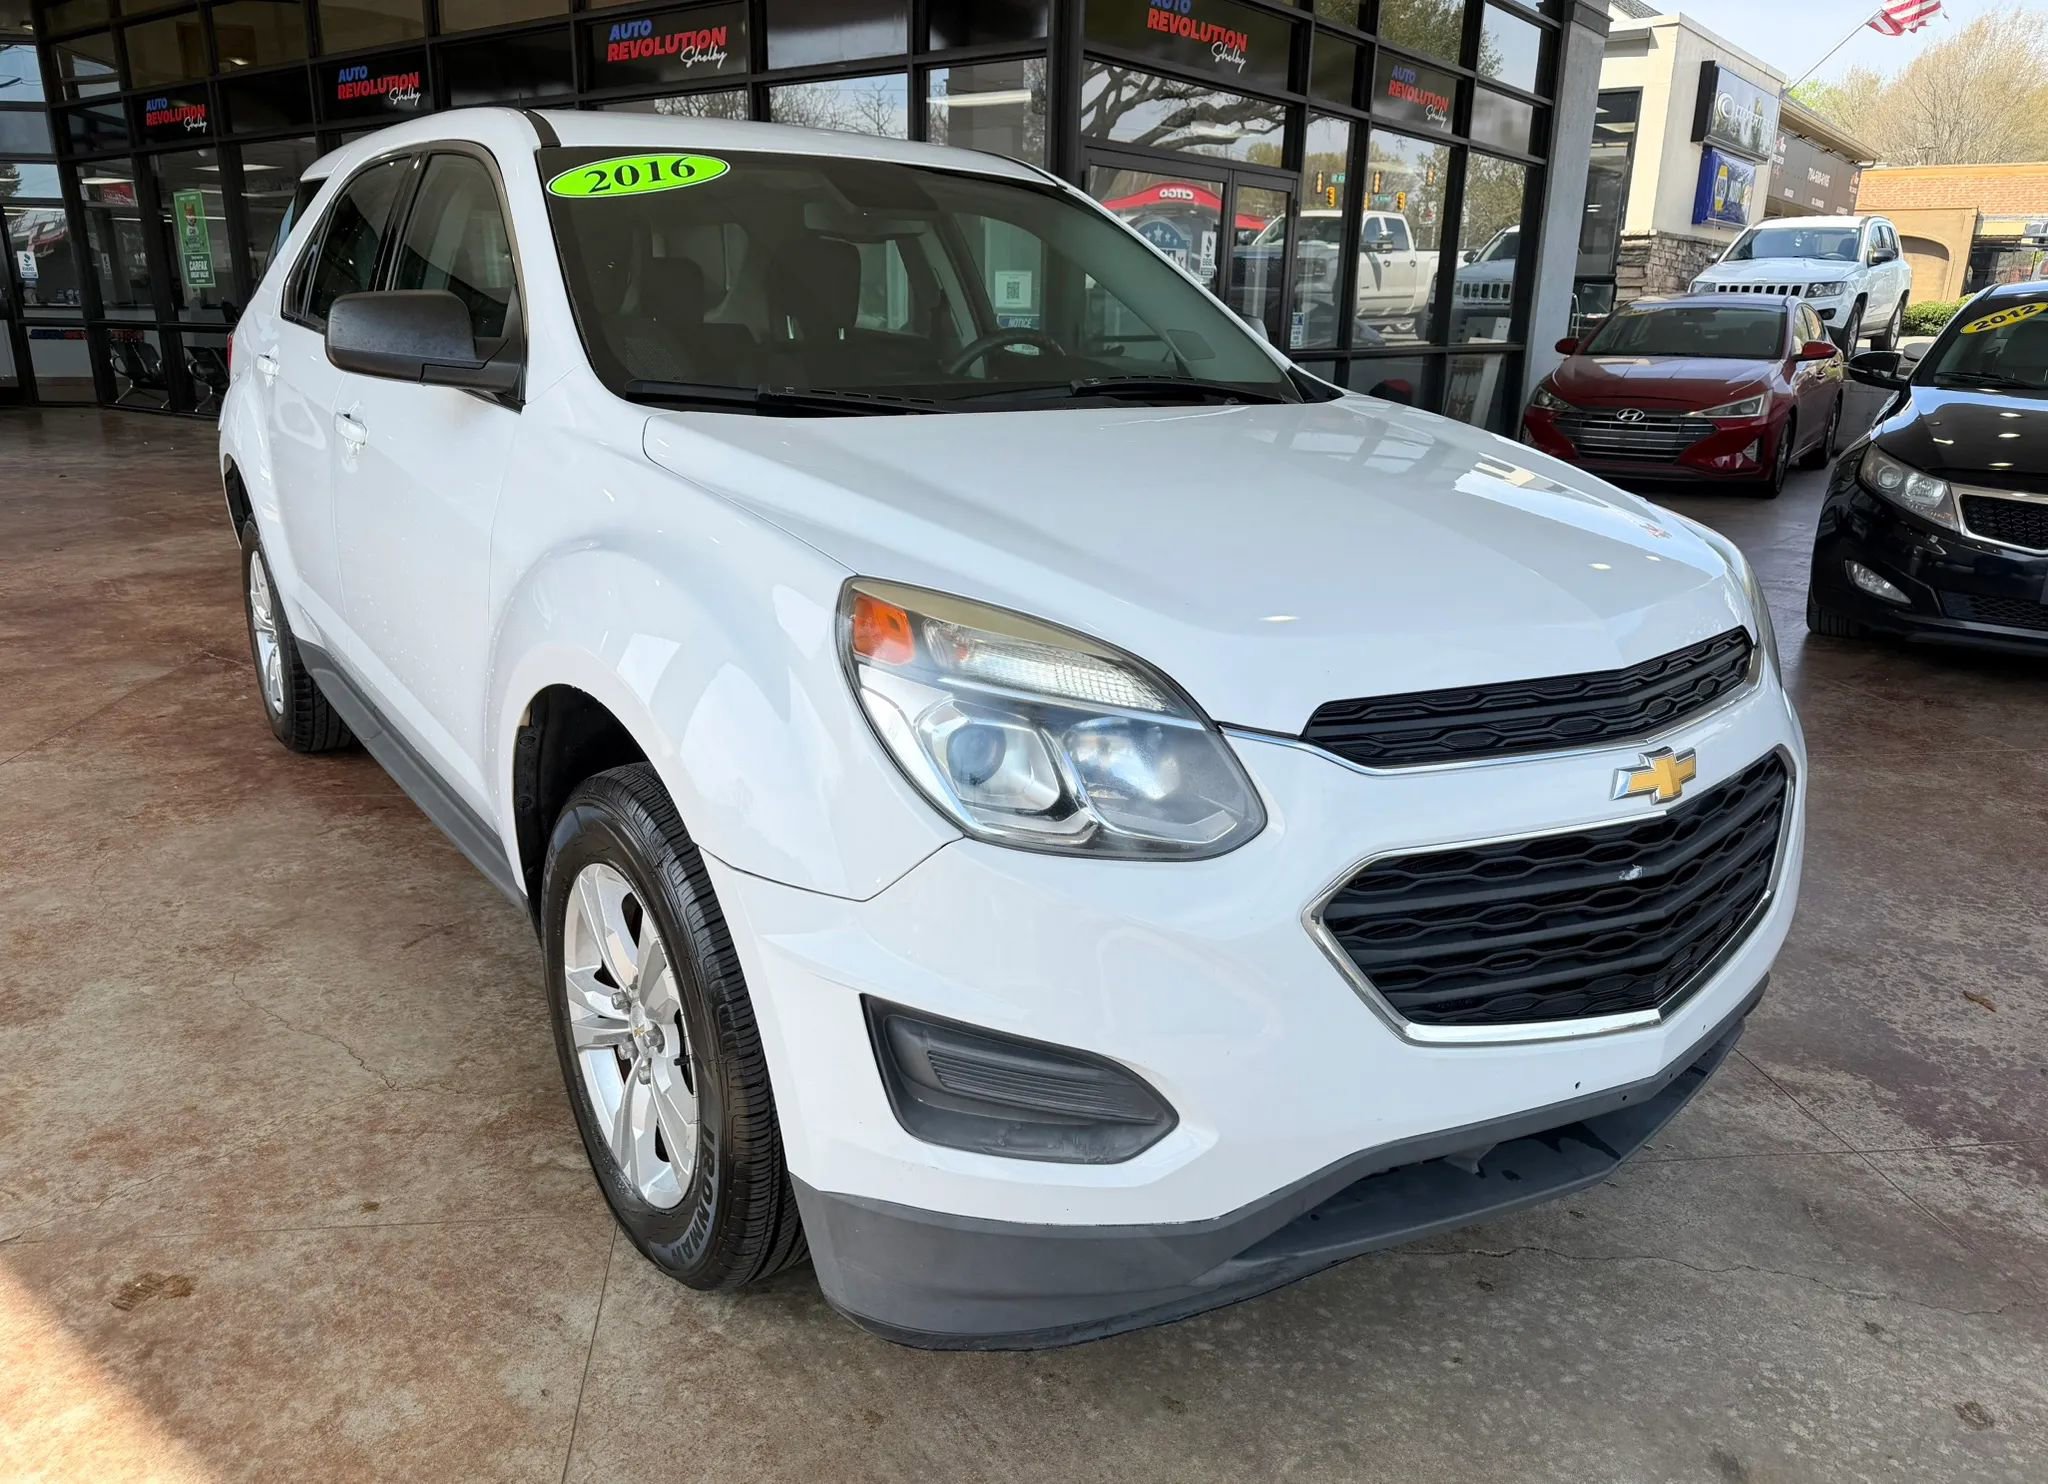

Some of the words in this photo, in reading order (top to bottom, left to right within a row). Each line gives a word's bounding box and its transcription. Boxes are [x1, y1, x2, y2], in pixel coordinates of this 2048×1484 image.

[609, 20, 652, 41] AUTO
[1147, 8, 1248, 52] REVOLUTION
[608, 26, 727, 62] REVOLUTION
[680, 41, 727, 69] Shelby
[1211, 41, 1246, 73] Shelby
[338, 65, 368, 82] AUTO
[338, 72, 419, 99] REVOLUTION
[1392, 65, 1416, 83] AUTO
[146, 98, 167, 111] AUTO
[388, 84, 421, 106] Shelby
[1388, 80, 1449, 112] REVOLUTION
[146, 104, 205, 127] REVOLUTION
[184, 114, 207, 133] Shelby
[1426, 104, 1447, 128] Shelby
[584, 157, 695, 193] 2016
[189, 260, 208, 271] CARFAX
[1008, 318, 1032, 328] NOTICE
[1974, 305, 2039, 331] 2012
[671, 1123, 715, 1265] IRONMAN
